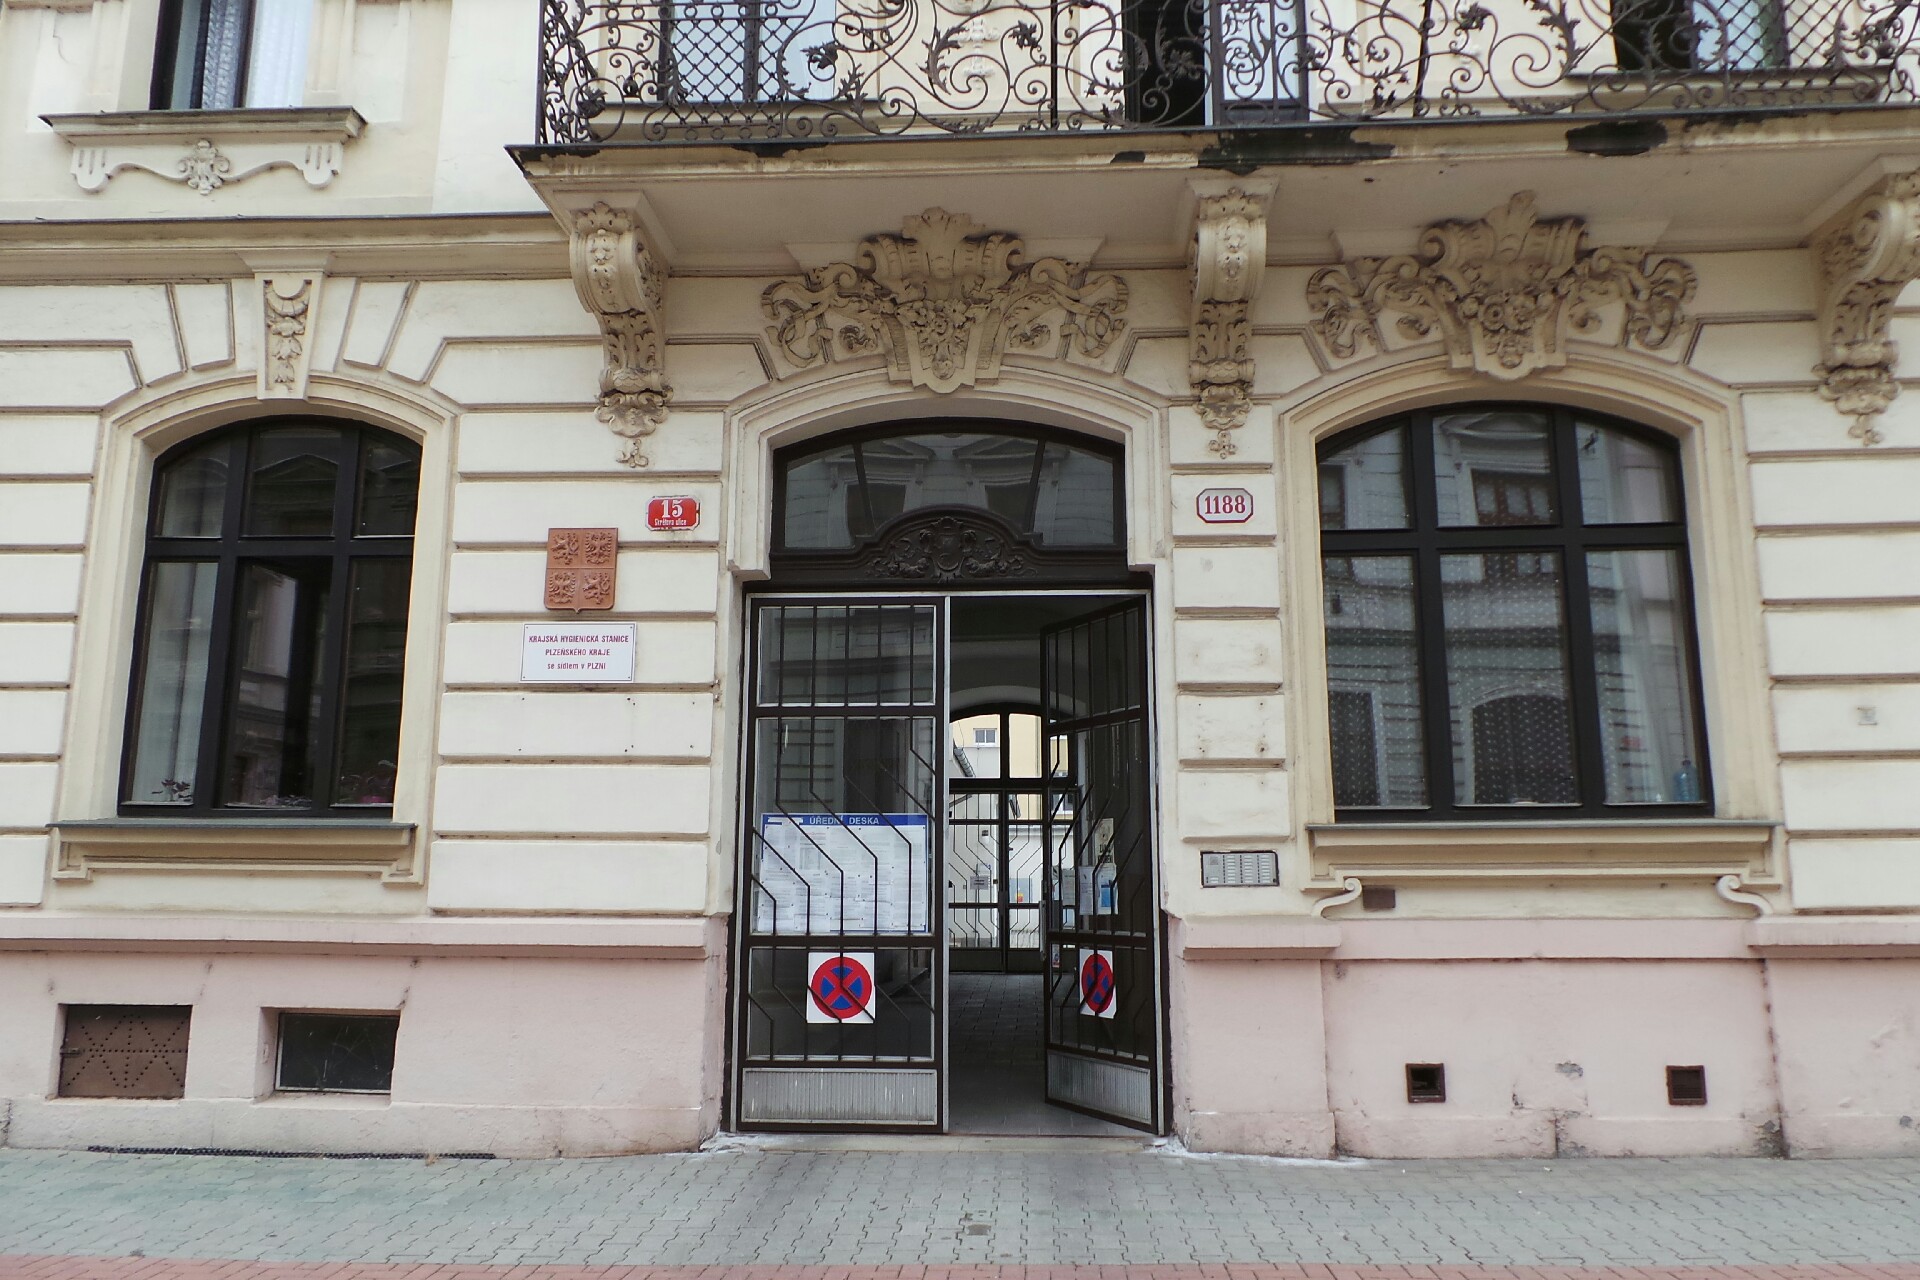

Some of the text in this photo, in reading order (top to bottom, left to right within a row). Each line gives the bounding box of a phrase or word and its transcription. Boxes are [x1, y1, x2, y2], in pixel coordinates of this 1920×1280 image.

[661, 499, 683, 518] 15
[1204, 495, 1246, 515] 1188
[528, 634, 629, 643] KRAJSKÁ HYGIENICKÁ STANICE
[545, 648, 611, 656] PLZEŇSKÉHO KRAJE
[557, 662, 579, 670] sídlem
[587, 662, 606, 670] PLZNI
[849, 816, 880, 825] DESKA
